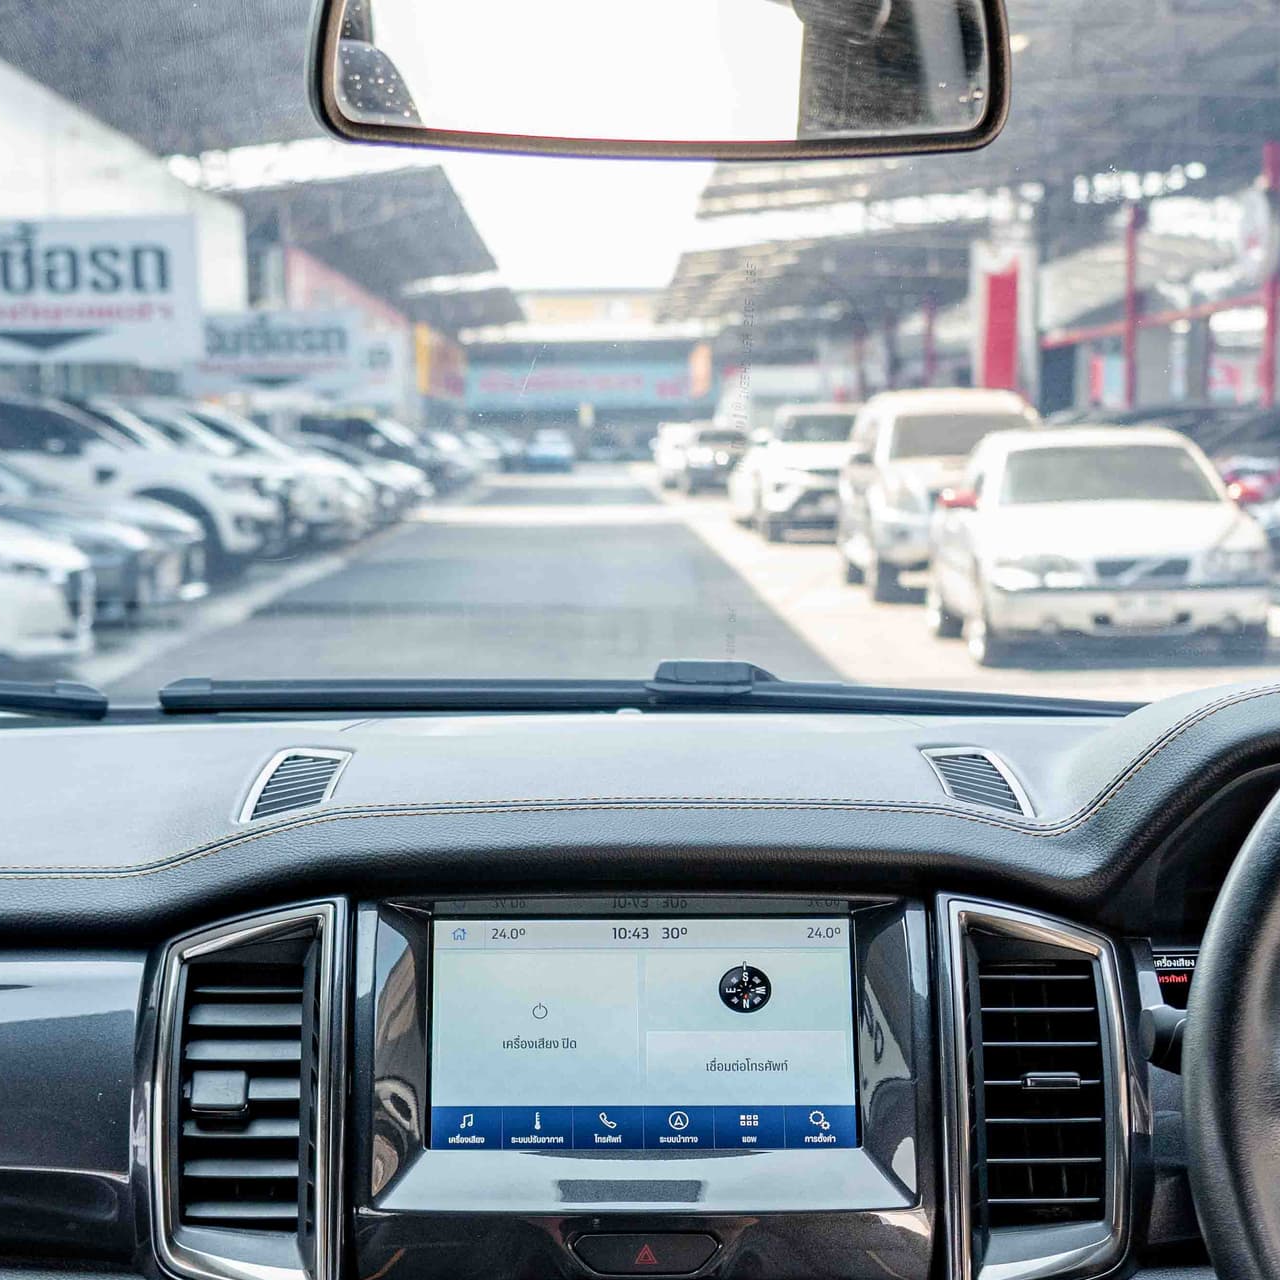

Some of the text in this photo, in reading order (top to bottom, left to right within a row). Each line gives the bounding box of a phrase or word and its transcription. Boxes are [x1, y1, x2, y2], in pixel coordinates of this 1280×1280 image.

[612, 927, 650, 940] 10:43
[742, 971, 749, 982] S
[742, 998, 750, 1009] N
[502, 1034, 577, 1049] เครื่องเสียง ปิด
[706, 1057, 790, 1072] เชื่อมต่อโทรศัพท์
[448, 1133, 485, 1144] เครื่องเสียง
[511, 1134, 564, 1144] ระบบปรับอากาศ
[594, 1133, 622, 1144] โทรศัพท์
[659, 1133, 699, 1144] ระบบนำทาง
[804, 1132, 837, 1144] การตั้งค่า
